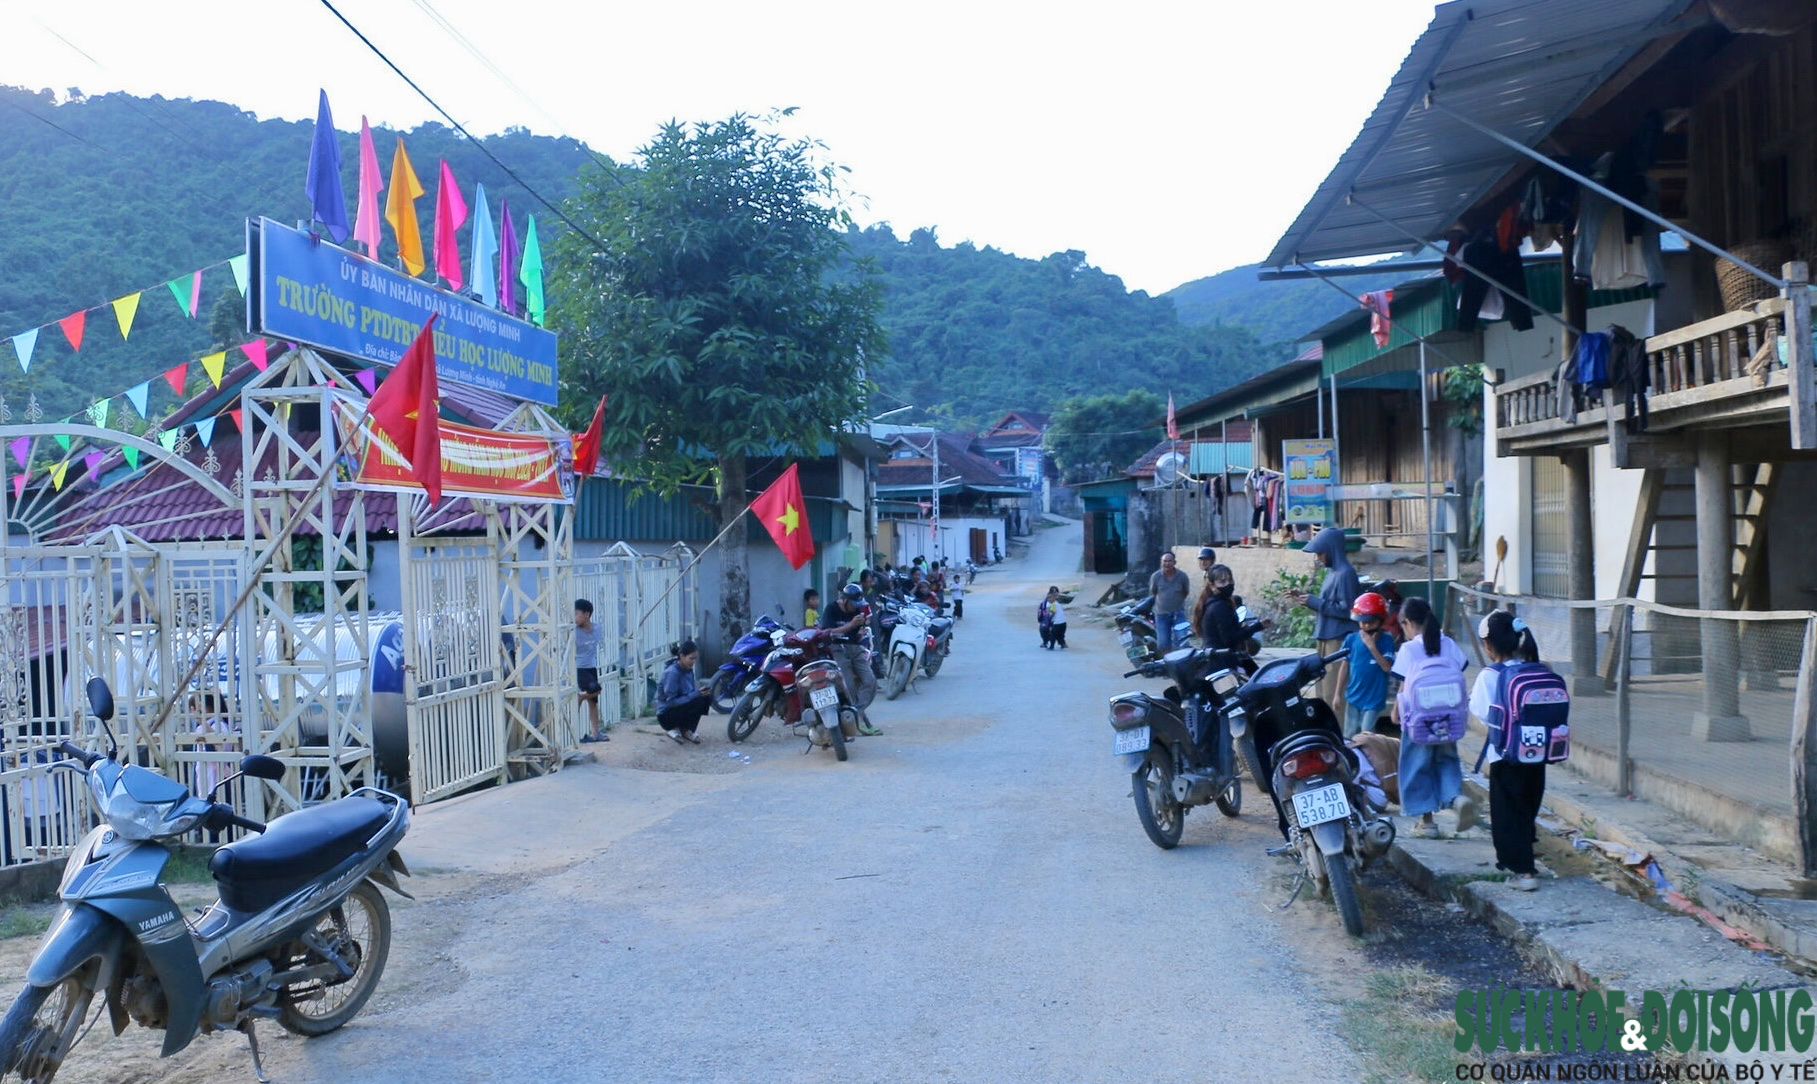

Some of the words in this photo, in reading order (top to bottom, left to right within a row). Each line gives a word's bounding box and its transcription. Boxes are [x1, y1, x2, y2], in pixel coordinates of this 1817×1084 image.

[341, 257, 357, 283] ỦY
[361, 270, 386, 295] BAN
[390, 281, 422, 308] NHÂN
[425, 294, 447, 317] DÂN
[449, 303, 463, 323] XÃ
[465, 311, 497, 333] LƯỢNG
[498, 322, 521, 342] MINH
[276, 275, 356, 329] TRƯỜNG
[459, 338, 485, 371] HỌC
[487, 347, 525, 381] LƯỢNG
[526, 360, 553, 386] MINH
[1300, 788, 1339, 809] 37-AB
[1300, 801, 1346, 824] 538.70
[138, 910, 175, 931] YAMAHA
